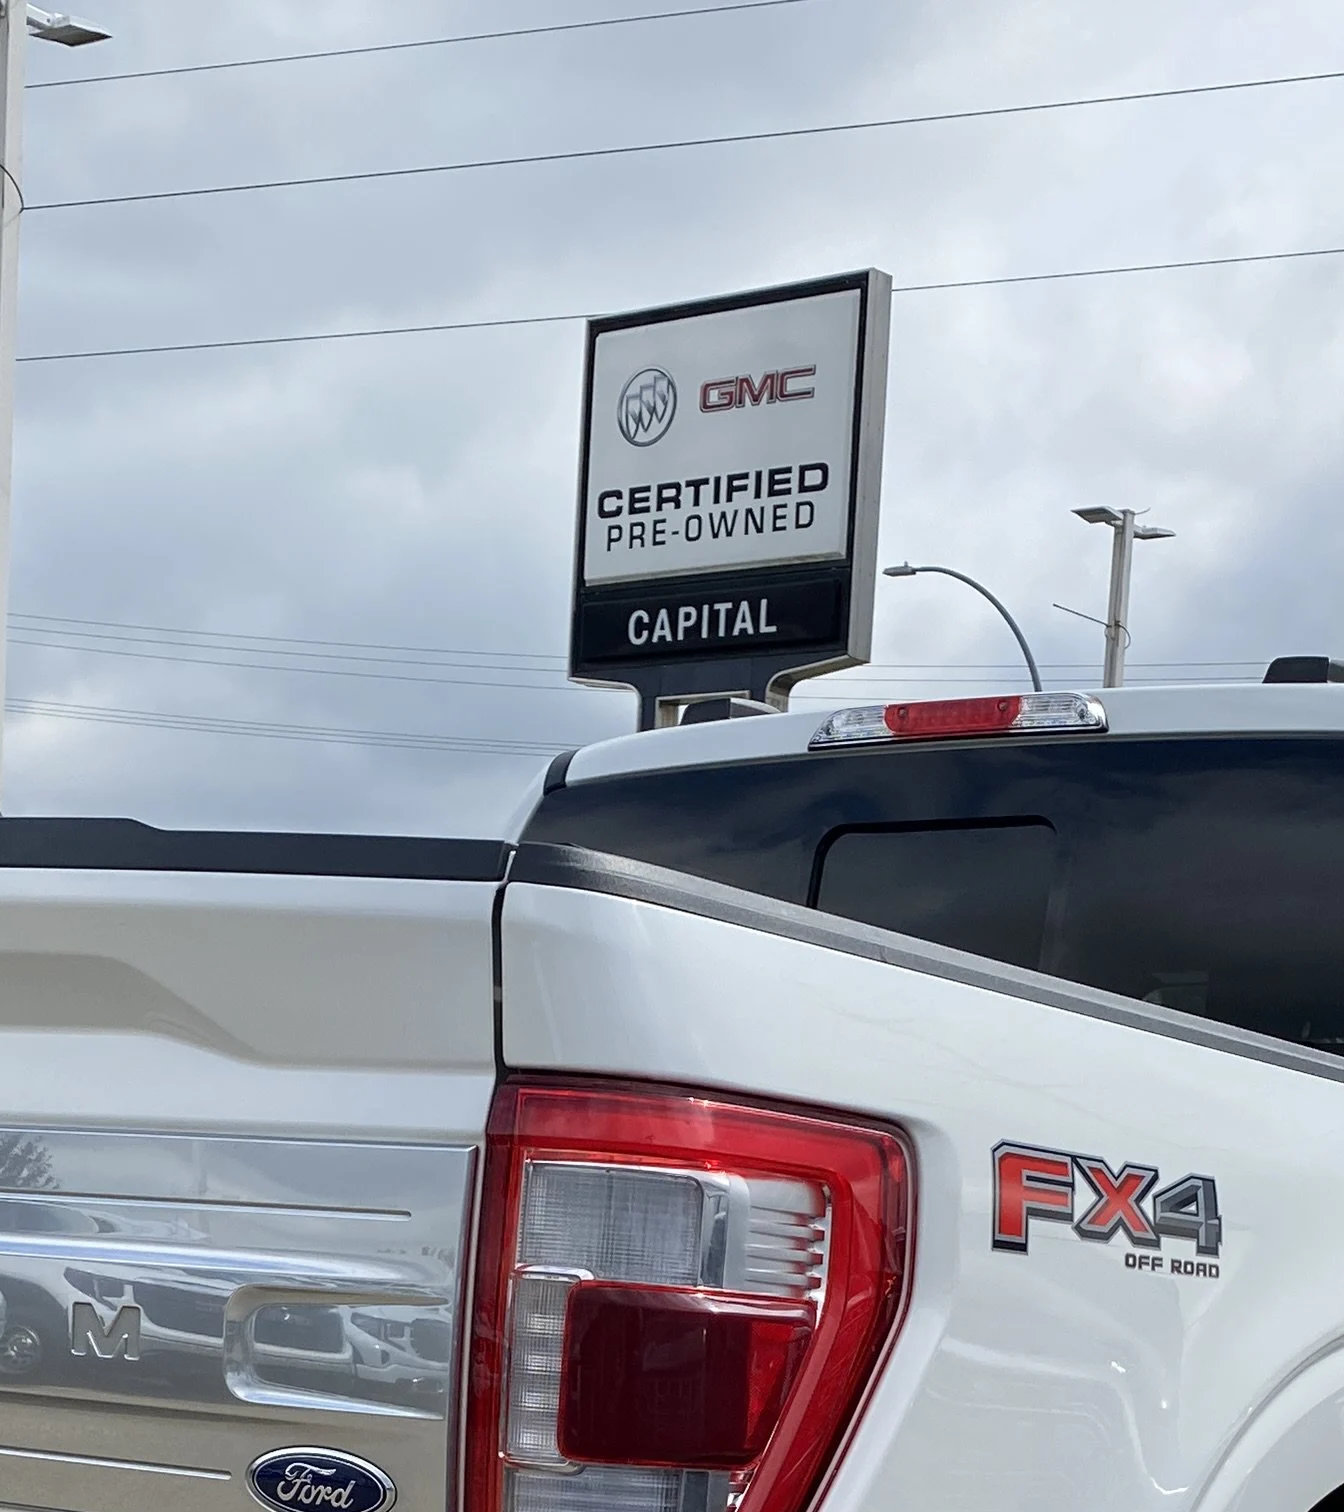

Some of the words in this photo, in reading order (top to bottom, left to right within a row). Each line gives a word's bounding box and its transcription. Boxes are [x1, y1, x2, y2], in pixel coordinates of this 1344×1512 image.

[700, 364, 816, 413] GMC
[598, 462, 829, 519] CERTIFIED
[607, 501, 815, 551] PRE-OWNED
[628, 599, 777, 646] CAPITAL
[991, 1139, 1222, 1258] FX4
[1125, 1253, 1163, 1271] OFF
[1171, 1259, 1220, 1278] ROAD
[276, 1462, 356, 1510] Ford
